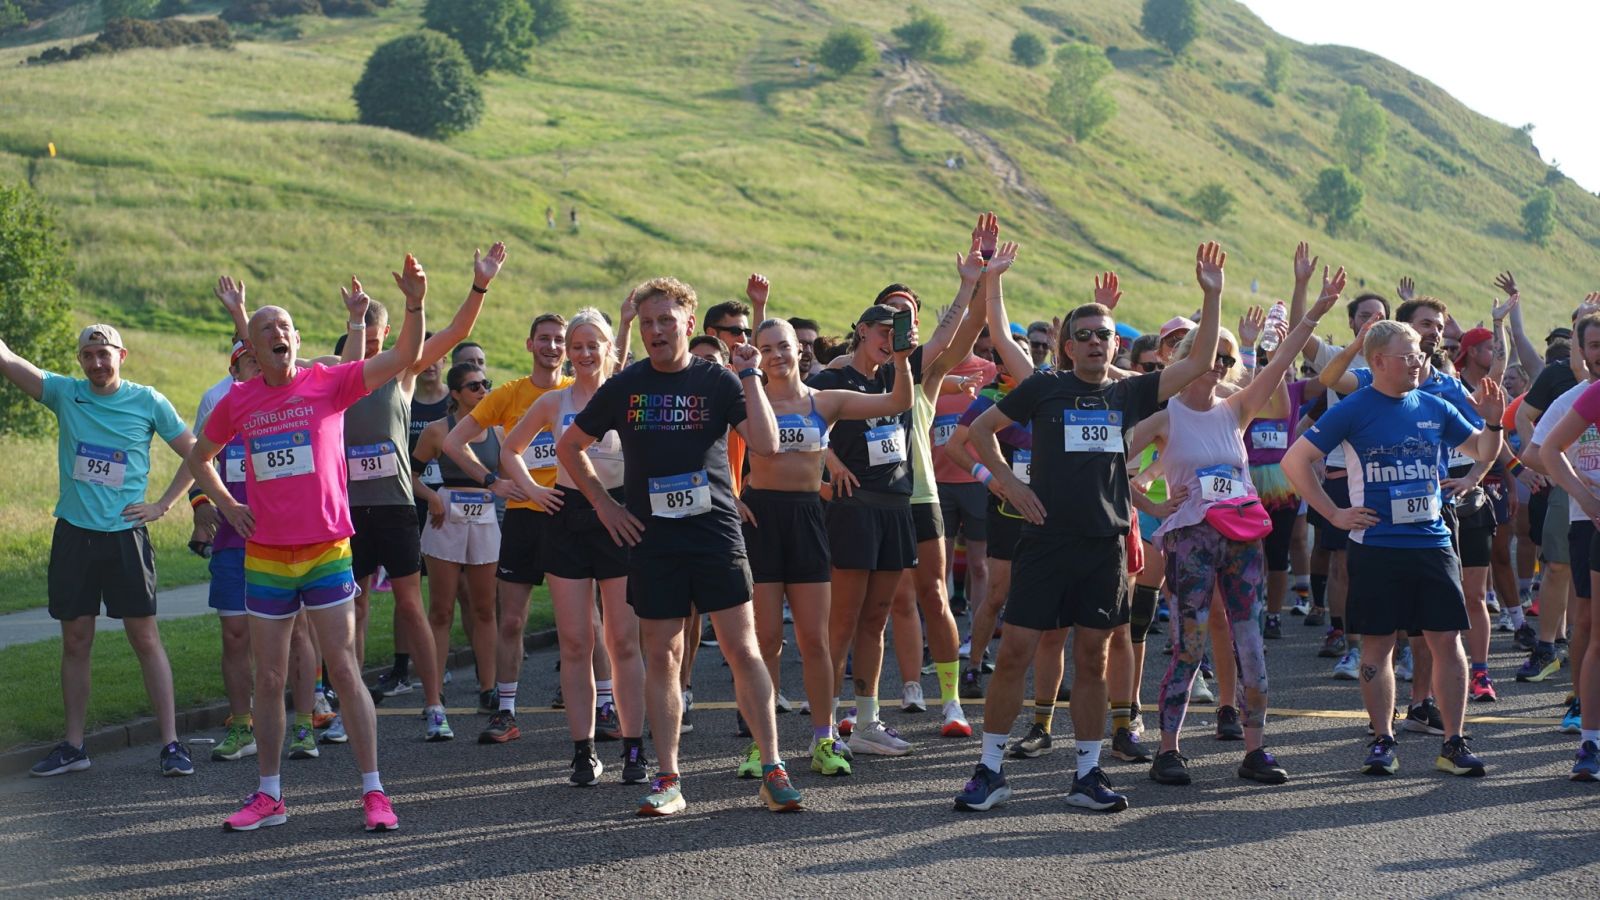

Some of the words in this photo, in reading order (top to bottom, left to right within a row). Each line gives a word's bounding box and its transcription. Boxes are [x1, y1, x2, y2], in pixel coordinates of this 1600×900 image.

[630, 394, 673, 408] PRIDE
[675, 395, 708, 409] NOT
[627, 409, 710, 422] PREJUDICE
[779, 428, 804, 443] 836
[1082, 426, 1108, 441] 830
[1261, 432, 1278, 442] 914
[534, 444, 557, 459] 856
[881, 439, 901, 454] 885
[267, 449, 295, 468] 855
[360, 457, 382, 471] 931
[87, 459, 111, 476] 954
[1213, 476, 1233, 495] 824
[666, 490, 694, 508] 895
[1407, 496, 1429, 513] 870
[463, 503, 483, 516] 922
